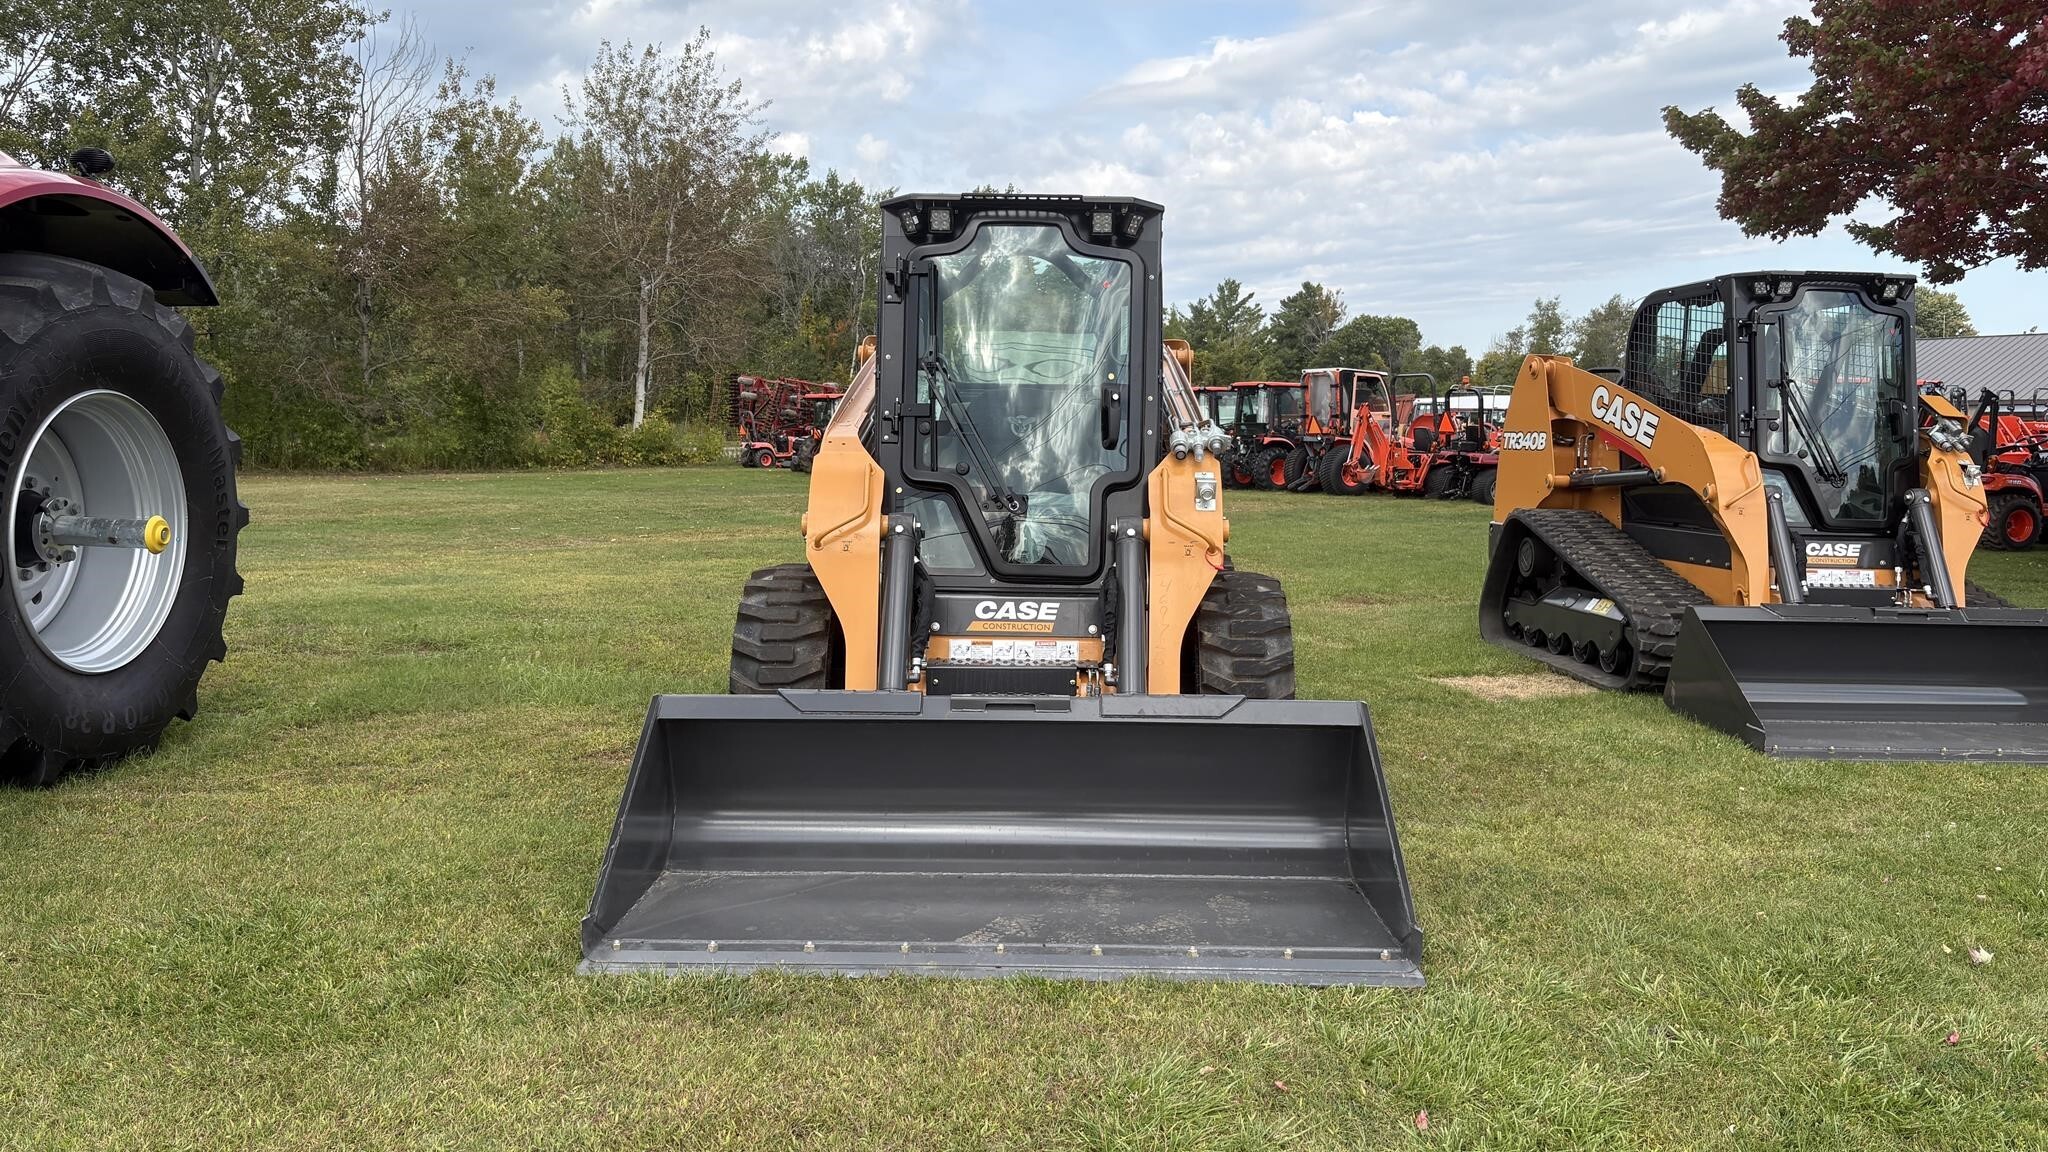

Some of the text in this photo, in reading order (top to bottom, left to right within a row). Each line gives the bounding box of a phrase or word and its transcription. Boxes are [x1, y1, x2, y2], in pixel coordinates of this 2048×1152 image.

[1591, 384, 1660, 449] CASE
[1503, 431, 1547, 451] TR340B
[1805, 542, 1862, 557] CASE
[974, 600, 1060, 620] CASE
[982, 622, 1051, 631] CONSTRUCTION
